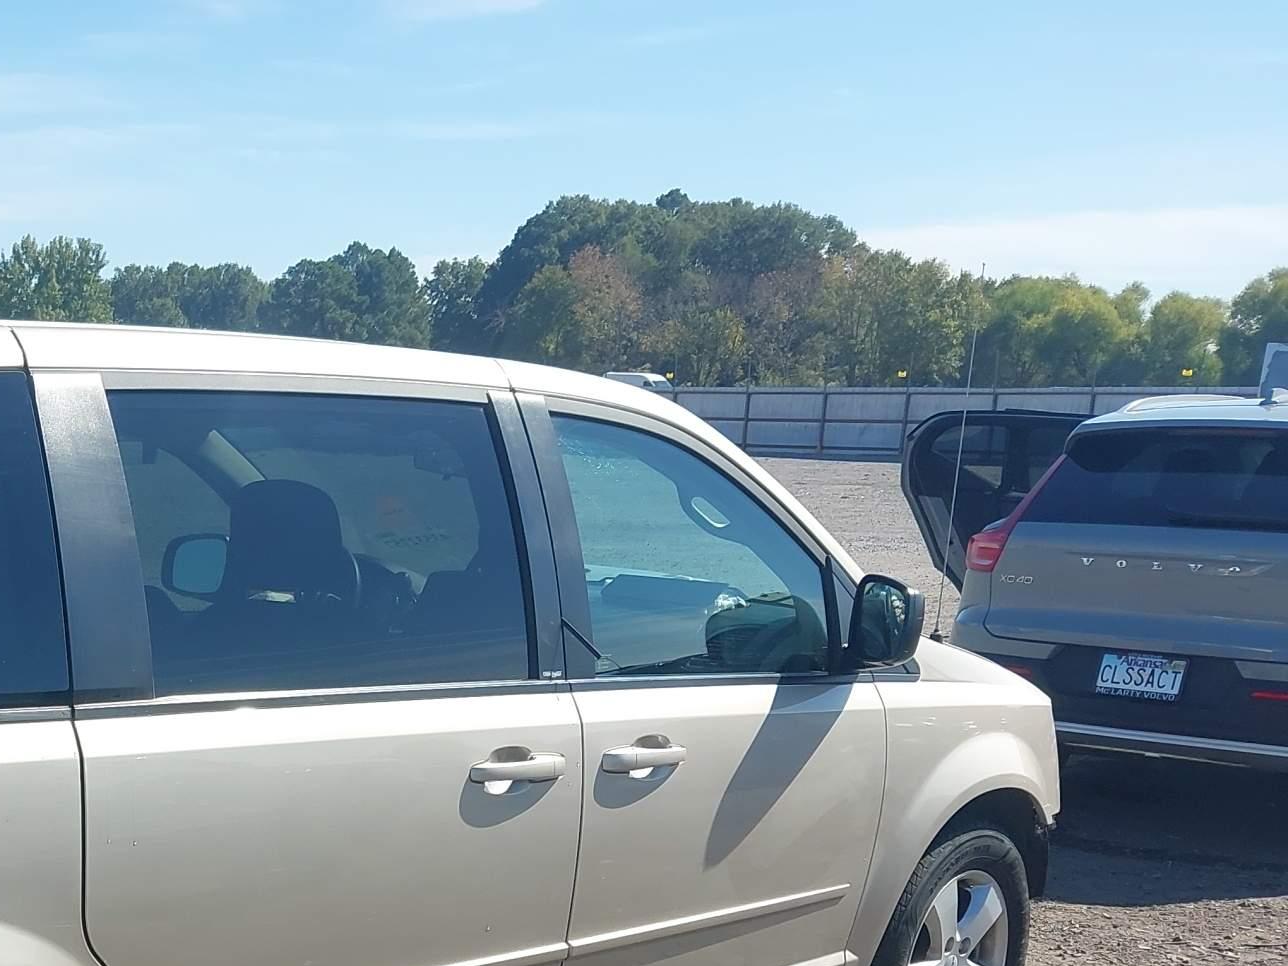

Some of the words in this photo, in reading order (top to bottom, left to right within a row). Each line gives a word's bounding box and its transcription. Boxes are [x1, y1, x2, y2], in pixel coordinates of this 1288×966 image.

[1080, 557, 1241, 575] VOLVO
[999, 573, 1033, 584] XC40
[1100, 664, 1182, 690] CLSSACT
[1143, 690, 1175, 701] VOLVO
